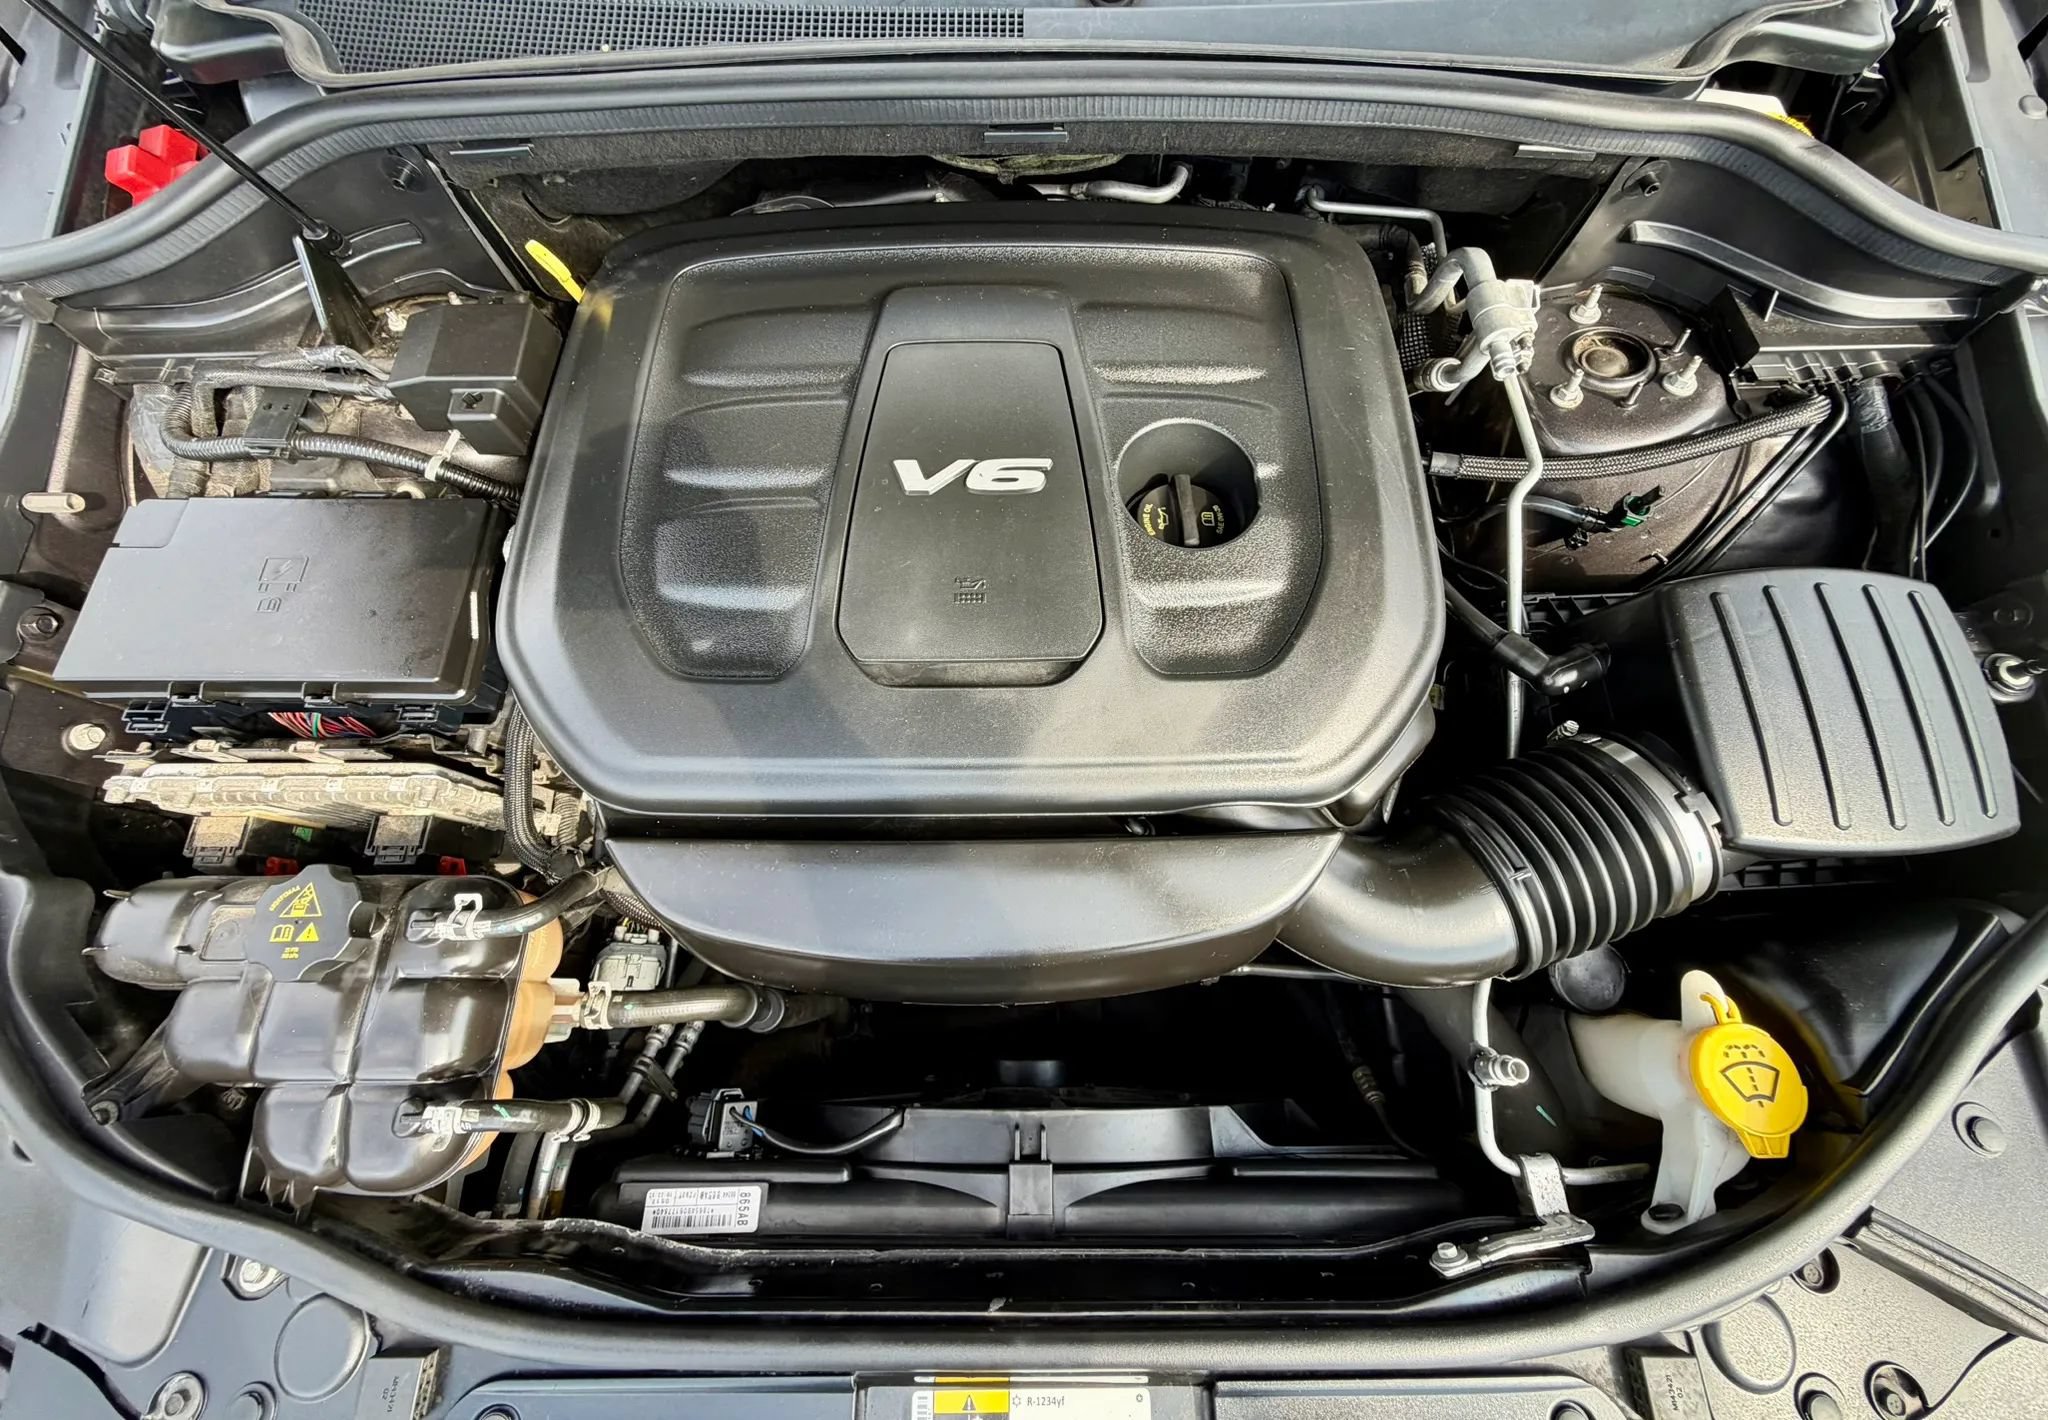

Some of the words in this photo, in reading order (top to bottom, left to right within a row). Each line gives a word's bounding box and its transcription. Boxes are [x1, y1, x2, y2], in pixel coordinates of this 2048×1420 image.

[892, 457, 1054, 496] V6
[737, 1191, 751, 1227] 865AB
[1026, 1395, 1065, 1407] R-1234yf
